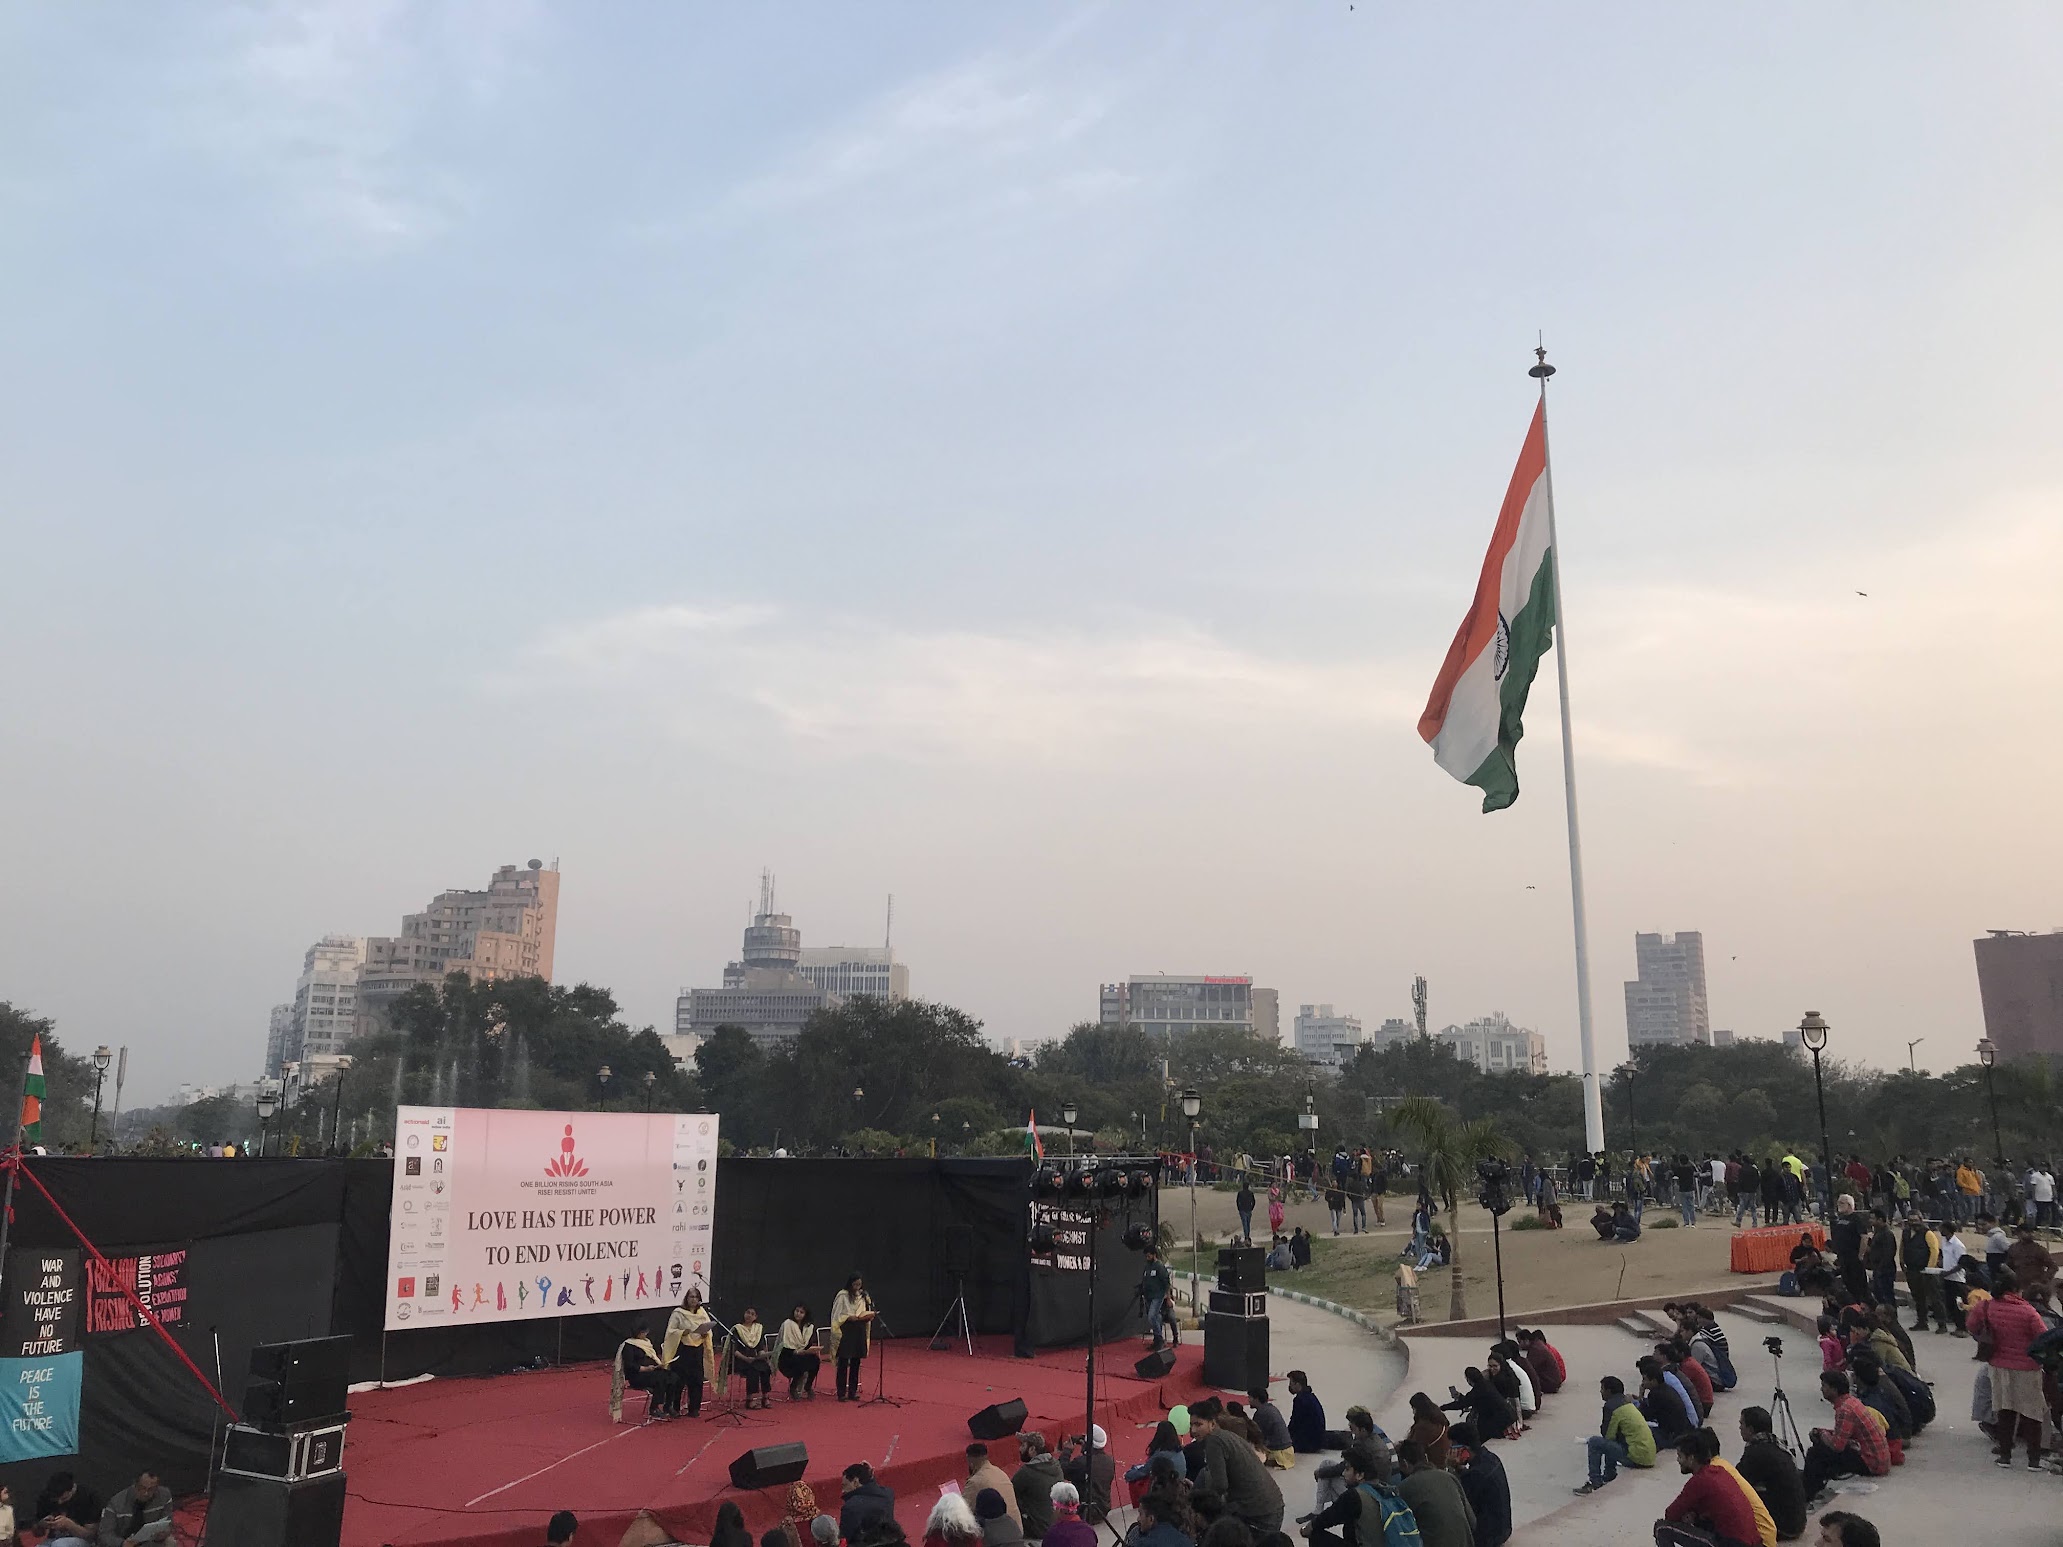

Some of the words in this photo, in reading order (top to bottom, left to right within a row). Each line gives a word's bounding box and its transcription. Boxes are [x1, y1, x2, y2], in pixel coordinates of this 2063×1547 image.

[554, 1188, 577, 1196] RESIST!
[558, 1180, 579, 1188] RISING
[467, 1210, 517, 1231] LOVE
[521, 1209, 556, 1229] HAS
[560, 1208, 595, 1228] THE
[599, 1206, 657, 1227] POWER
[672, 1221, 687, 1232] rahi
[152, 1250, 186, 1269] SOLIDARITY
[485, 1246, 510, 1266] TO
[515, 1244, 551, 1264] END
[555, 1240, 639, 1262] VIOLENCE
[1056, 1253, 1078, 1270] WOMEN
[41, 1258, 64, 1273] WAR
[40, 1274, 62, 1289] AND
[152, 1269, 179, 1288] AGAINST
[23, 1288, 74, 1305] VIOLENCE
[34, 1306, 62, 1322] HAVE
[94, 1297, 136, 1332] RISING
[39, 1323, 54, 1338] NO
[21, 1338, 63, 1356] FUTURE
[19, 1367, 55, 1384] PEACE
[28, 1385, 41, 1400] IS
[22, 1401, 44, 1416] THE
[12, 1415, 53, 1432] FUTURE
